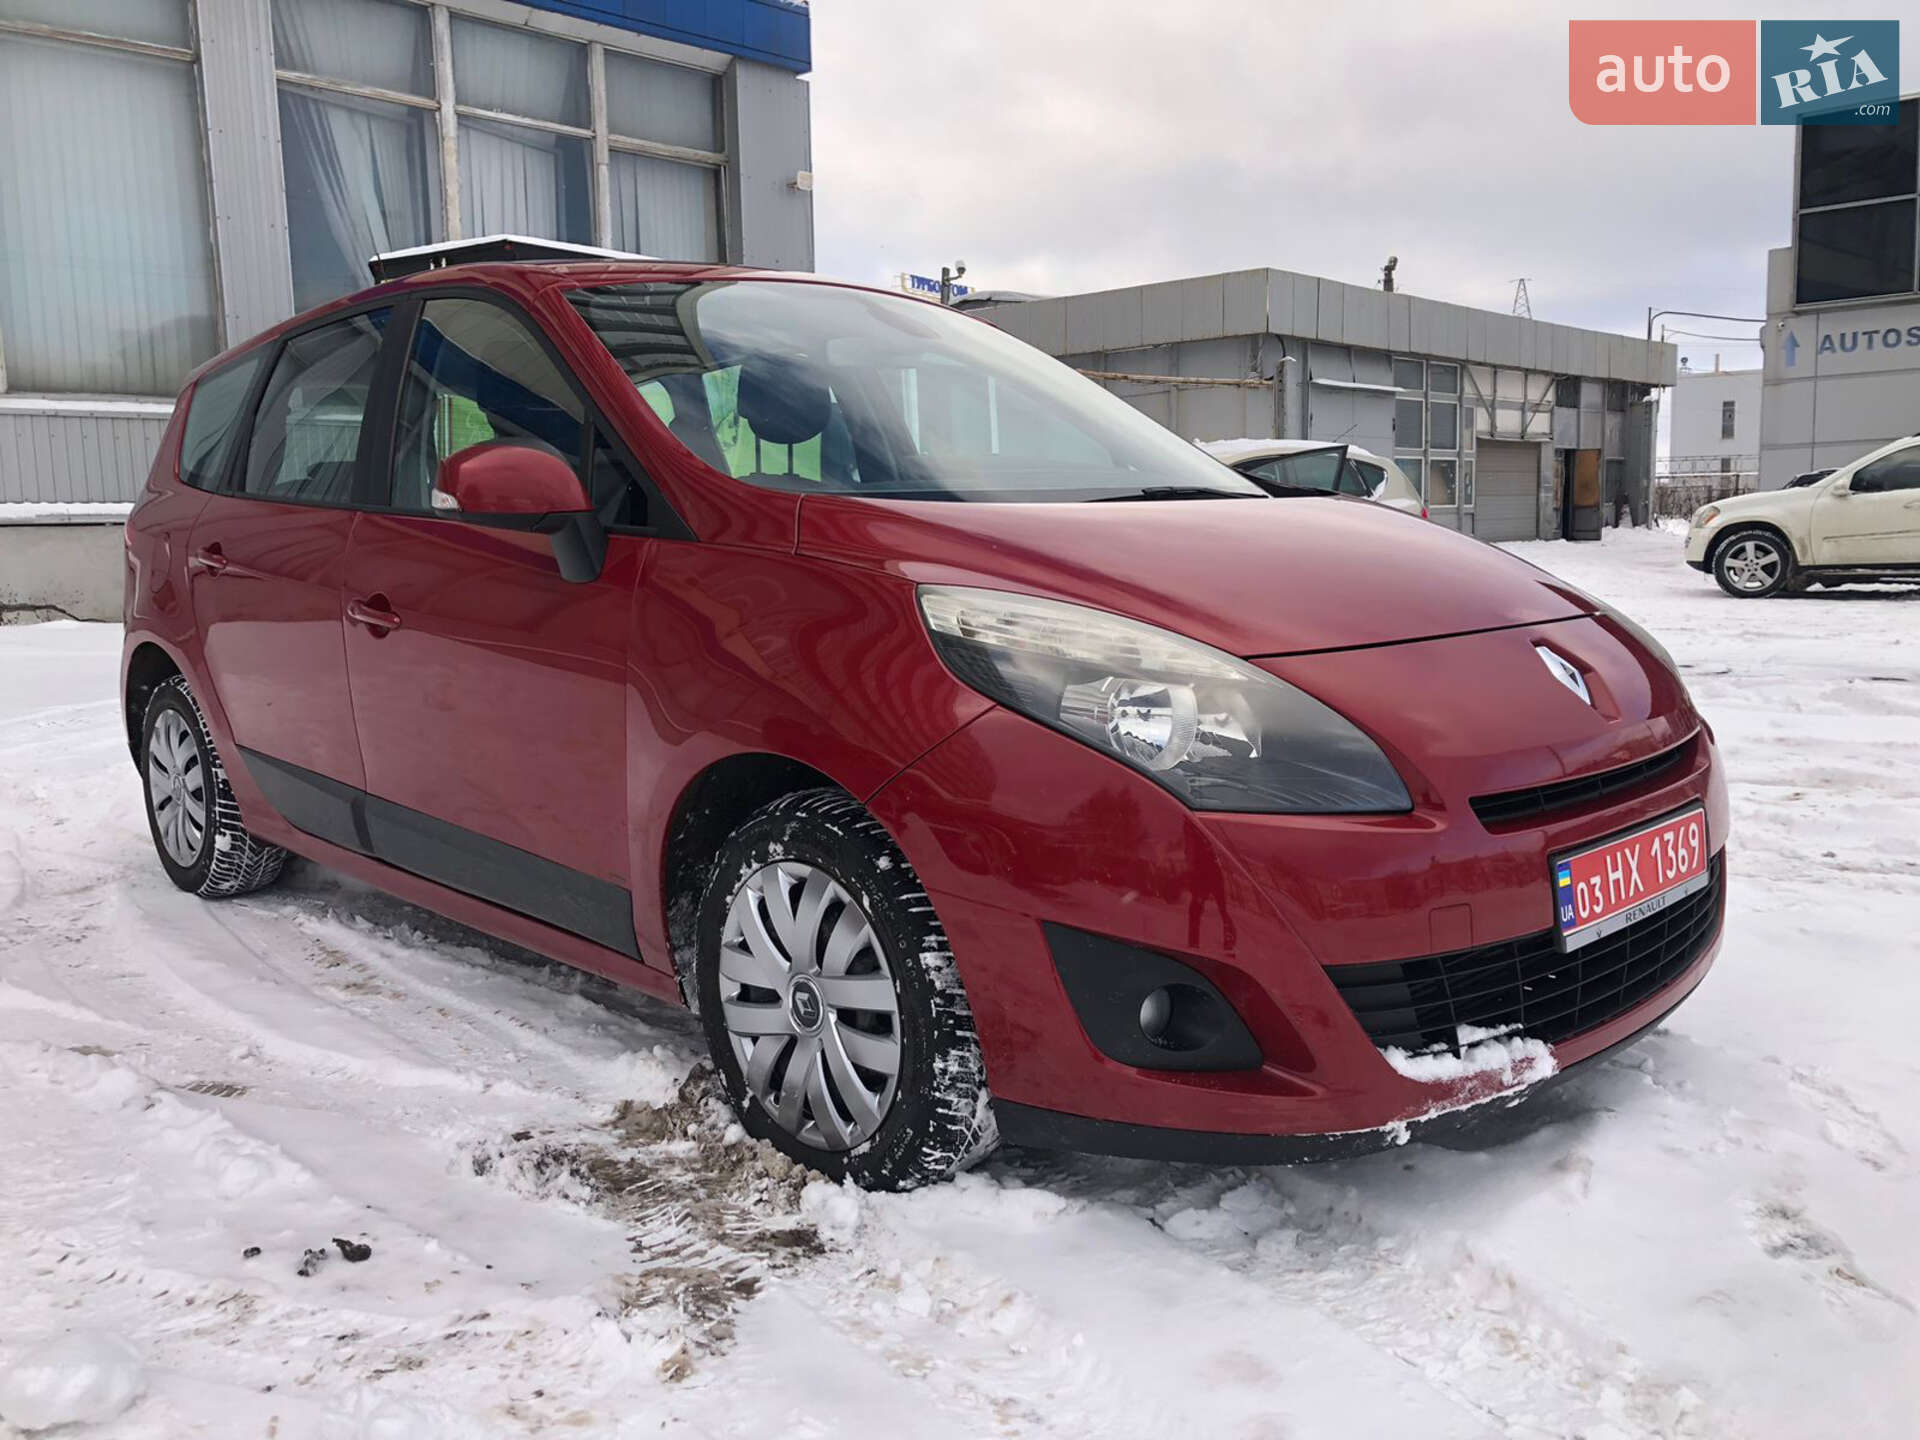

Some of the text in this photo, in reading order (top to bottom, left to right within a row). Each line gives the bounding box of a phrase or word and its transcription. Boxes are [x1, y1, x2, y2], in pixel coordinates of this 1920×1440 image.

[1576, 822, 1700, 919] 03 HX 1369
[1561, 903, 1575, 922] UA
[1625, 896, 1668, 925] RENAULT
